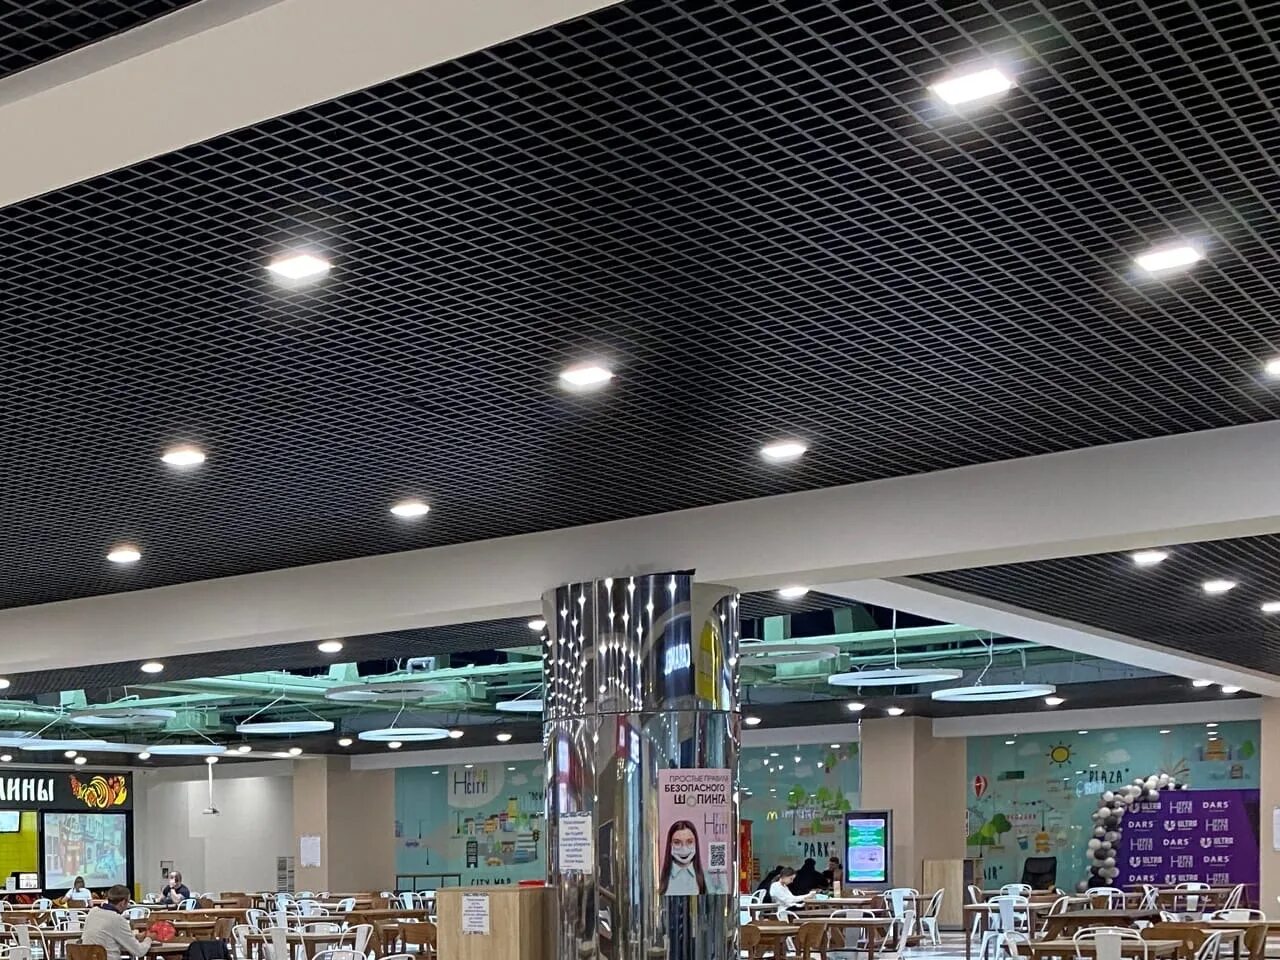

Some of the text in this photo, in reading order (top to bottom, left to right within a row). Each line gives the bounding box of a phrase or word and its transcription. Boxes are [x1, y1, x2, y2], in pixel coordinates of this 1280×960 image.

[1089, 769, 1123, 785] PLAZA
[664, 783, 725, 793] БЕЗОПАСНОГО
[1203, 801, 1229, 809] DARS
[1128, 820, 1154, 828] DARS
[1163, 838, 1189, 846] DARS
[804, 842, 829, 857] PARK
[1203, 855, 1230, 863] DARS
[1129, 874, 1155, 882] DARS
